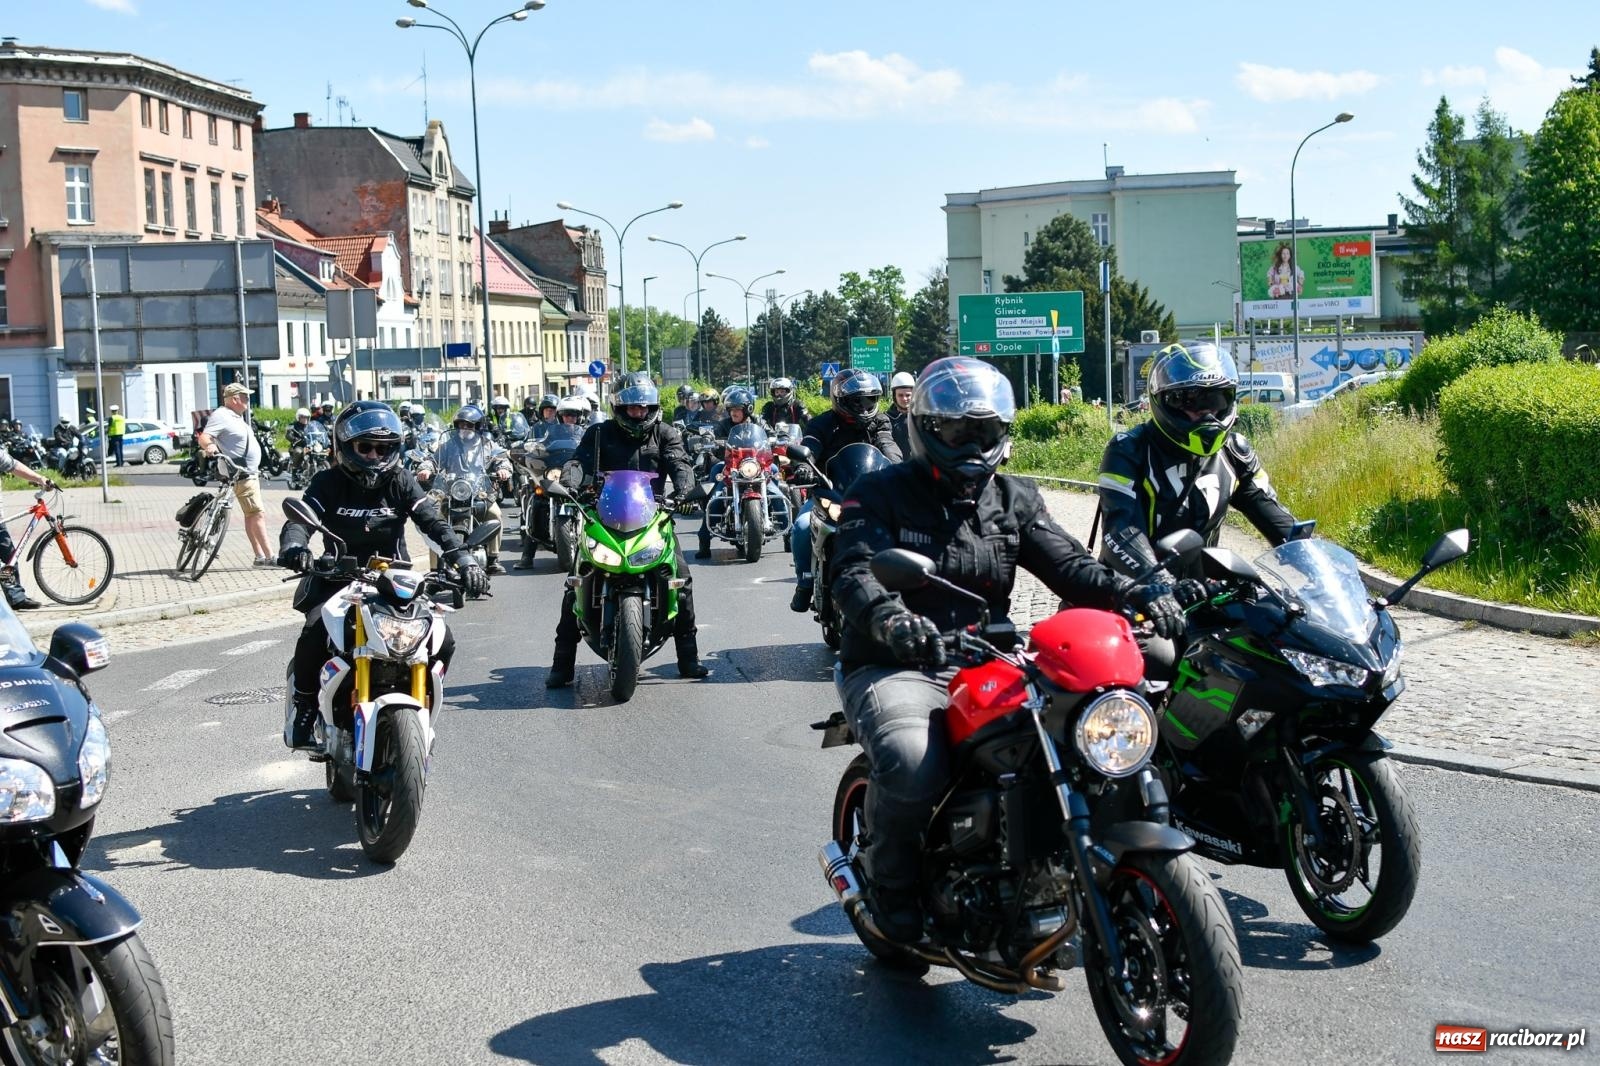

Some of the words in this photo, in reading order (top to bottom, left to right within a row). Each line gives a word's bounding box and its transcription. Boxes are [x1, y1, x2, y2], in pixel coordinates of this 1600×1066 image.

[995, 297, 1024, 305] Rybnik
[994, 307, 1027, 315] Gliwice
[1020, 318, 1044, 326] Miejski
[995, 343, 1022, 352] Opole
[336, 506, 396, 517] DAINESE
[1174, 818, 1242, 855] Kawasaki
